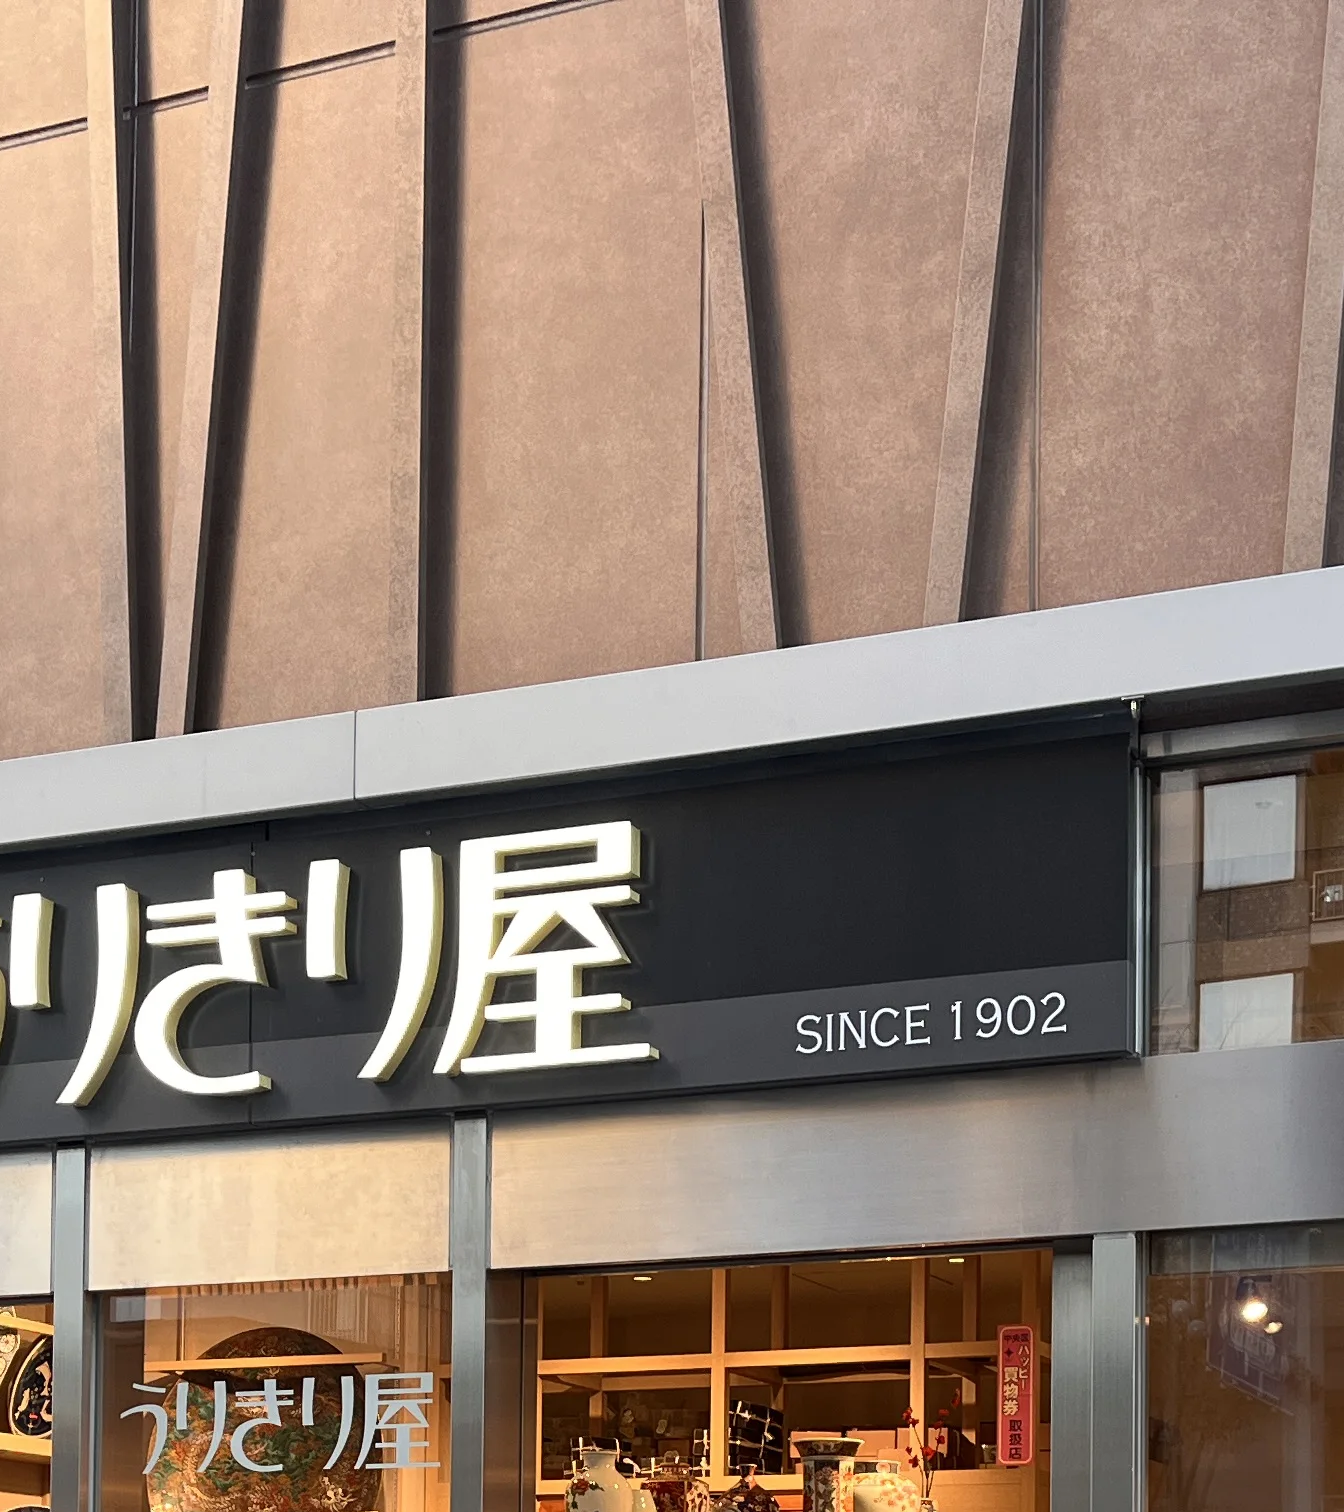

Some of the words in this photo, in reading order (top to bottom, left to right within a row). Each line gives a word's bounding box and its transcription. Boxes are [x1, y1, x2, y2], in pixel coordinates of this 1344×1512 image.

[795, 1003, 931, 1054] SINCE
[950, 991, 1067, 1041] 1902
[1003, 1366, 1019, 1416] 買物券
[120, 1372, 441, 1474] うりきり屋
[1008, 1419, 1023, 1460] 取扱店
